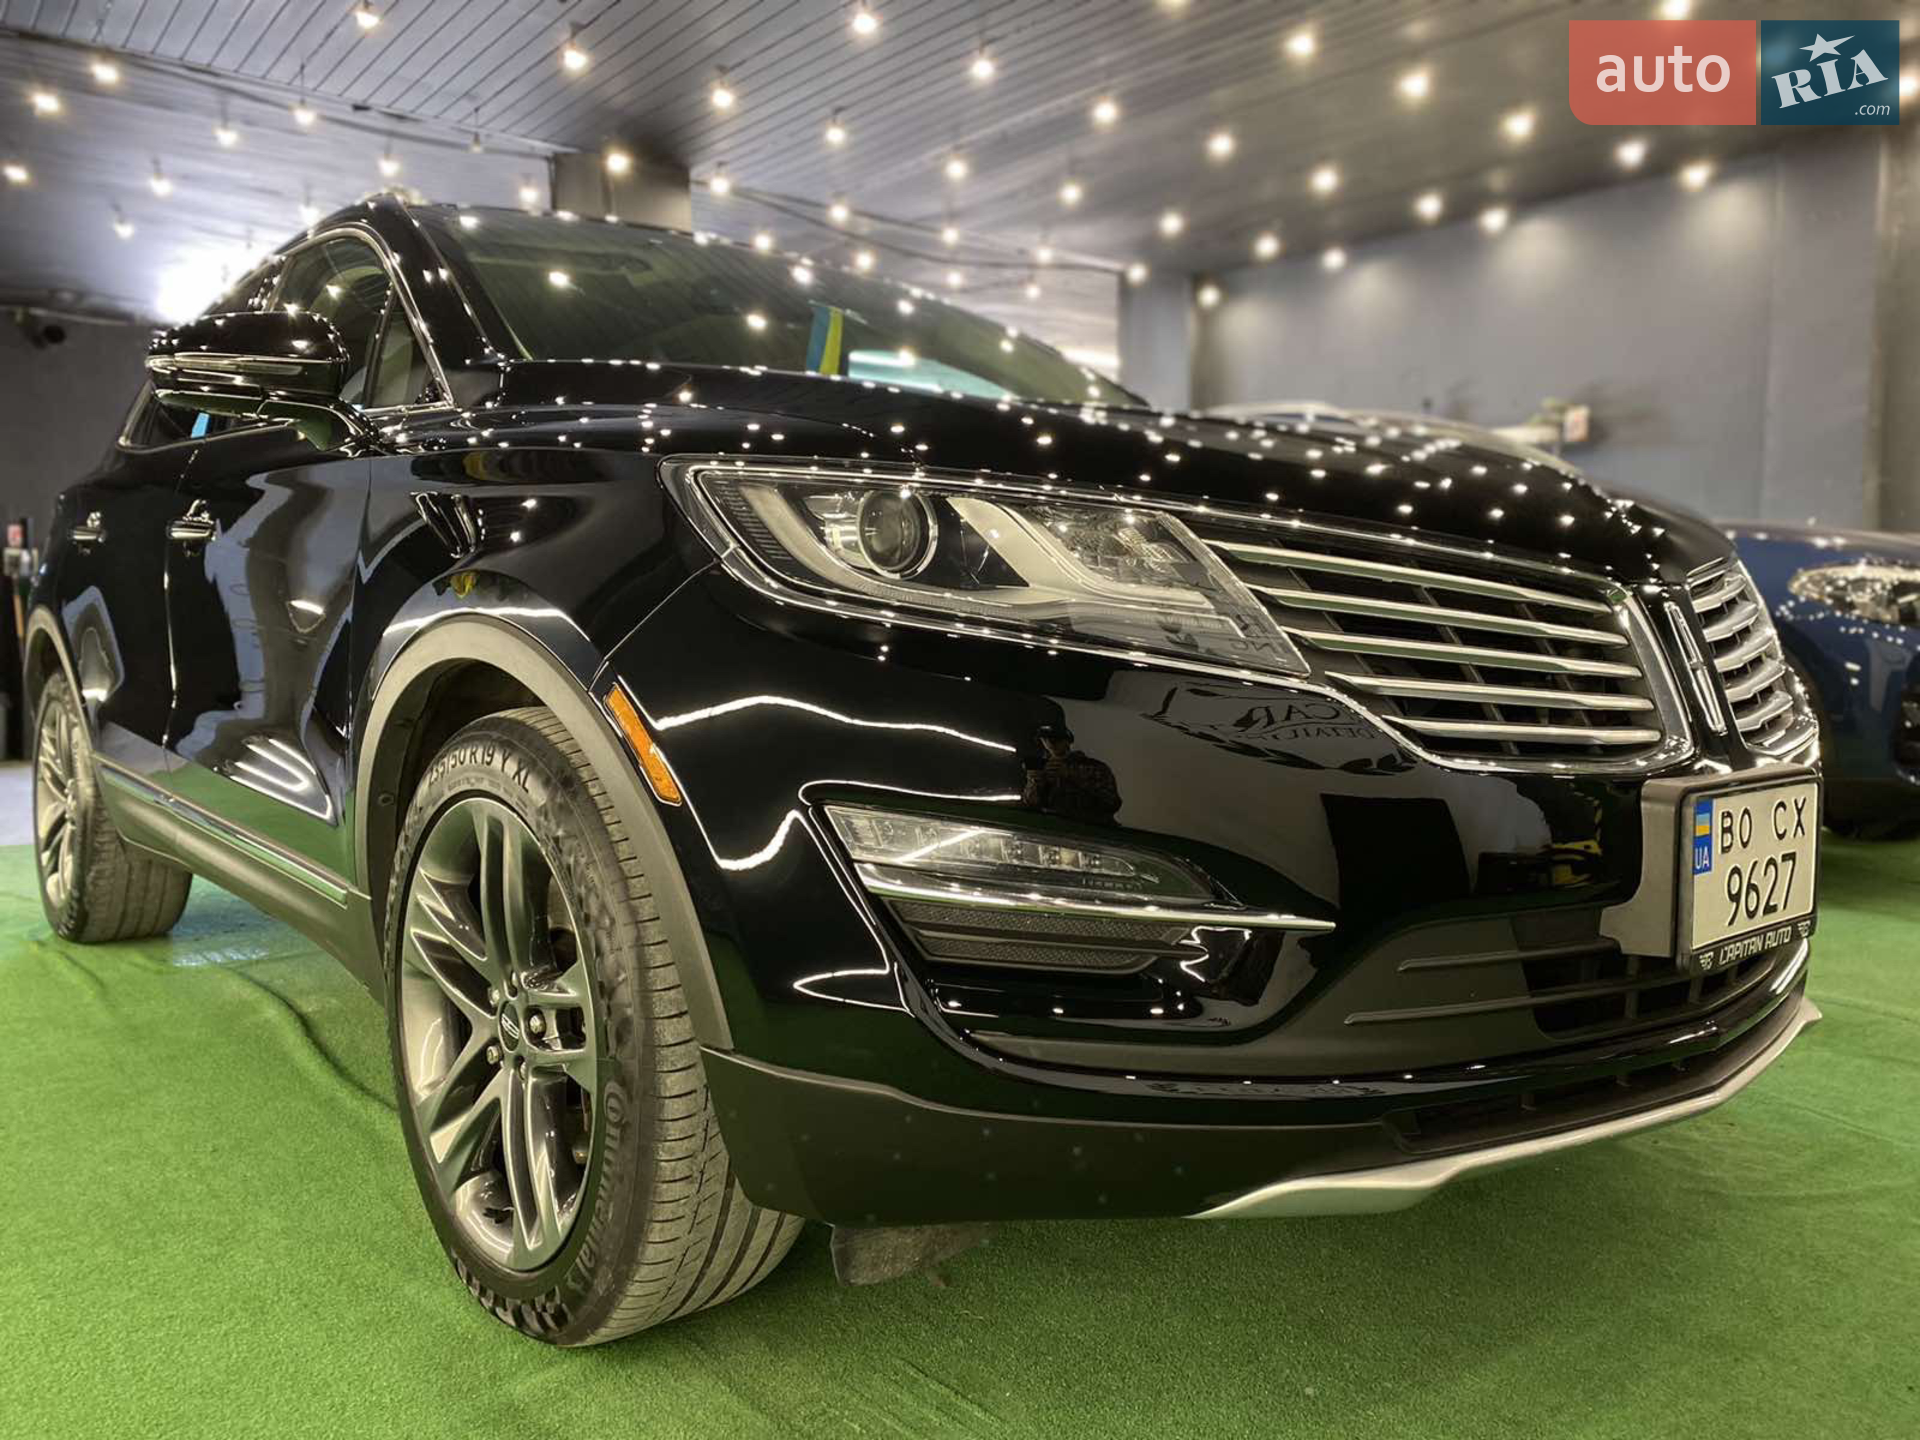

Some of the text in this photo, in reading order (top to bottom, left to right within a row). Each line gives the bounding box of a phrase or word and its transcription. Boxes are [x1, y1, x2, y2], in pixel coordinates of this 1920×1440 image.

[512, 757, 529, 793] XL
[1720, 797, 1807, 855] BO CX
[1694, 845, 1710, 870] UA
[1727, 851, 1797, 927] 9627
[1764, 926, 1792, 950] AUTO
